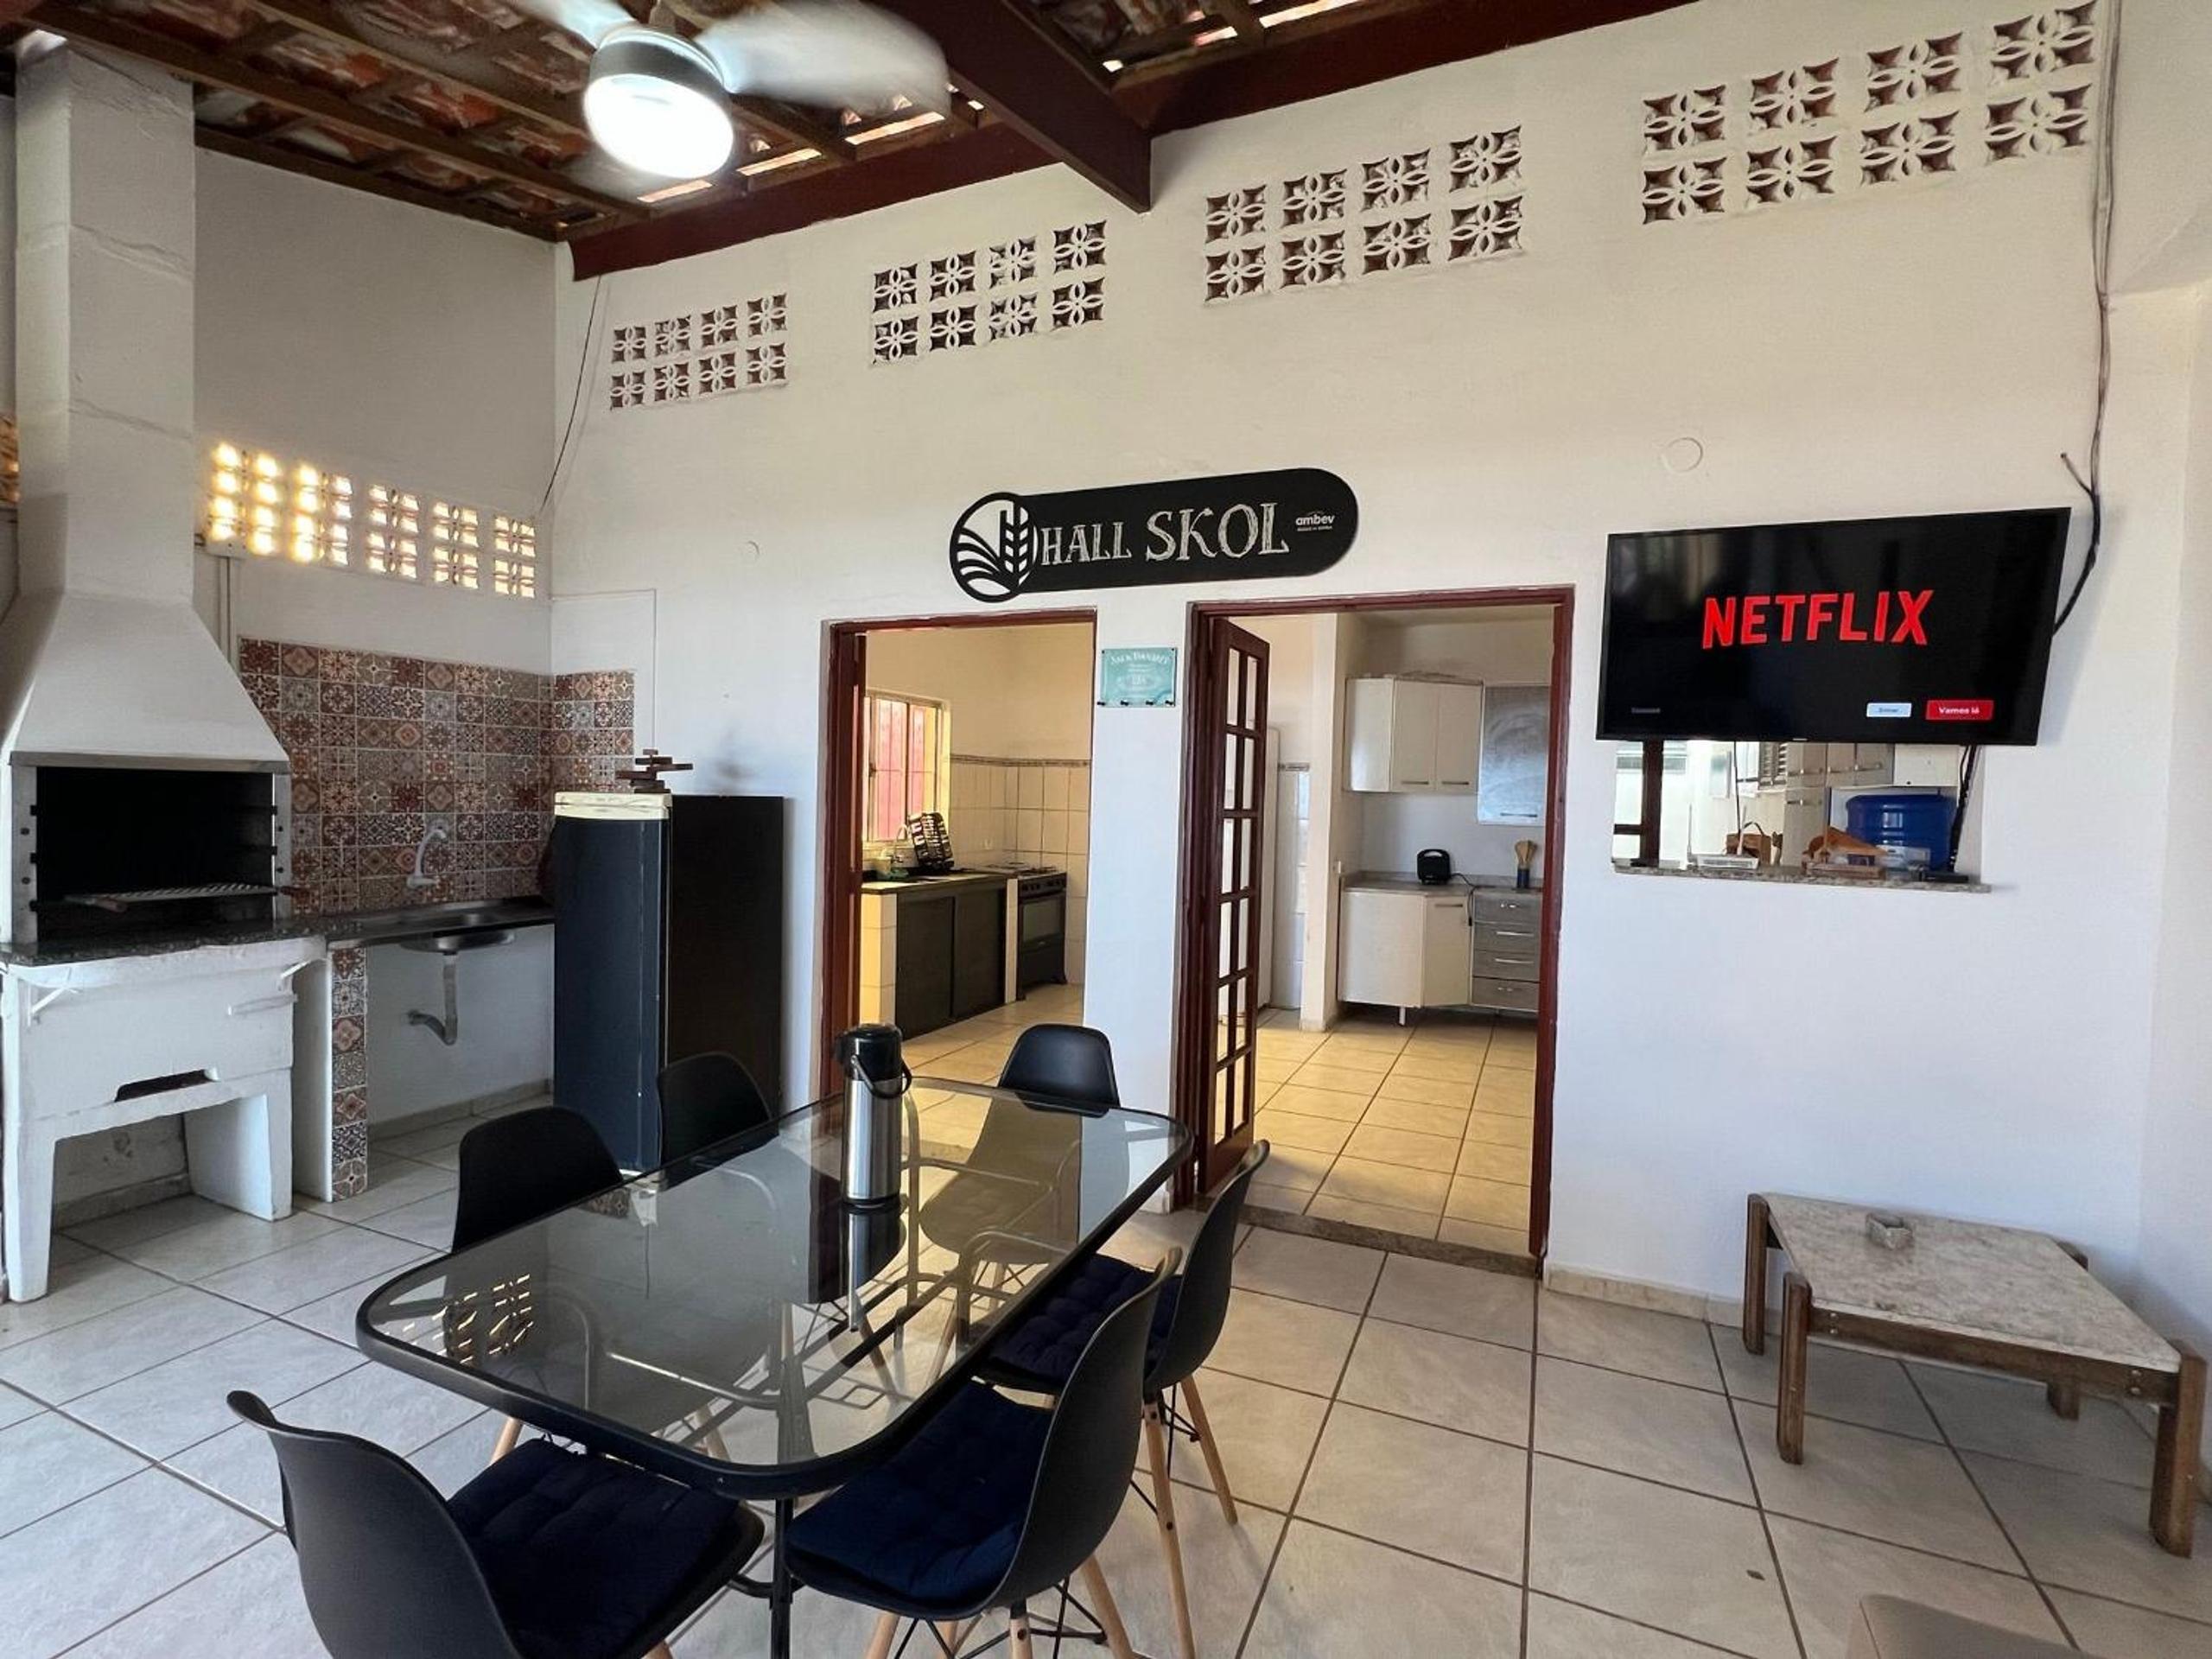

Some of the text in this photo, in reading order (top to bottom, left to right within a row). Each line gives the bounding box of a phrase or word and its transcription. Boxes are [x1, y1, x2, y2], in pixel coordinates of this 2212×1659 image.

[1040, 502, 1290, 566] HALL SKOL
[1295, 513, 1335, 525] ambev
[1702, 589, 1935, 650] NETFLIX
